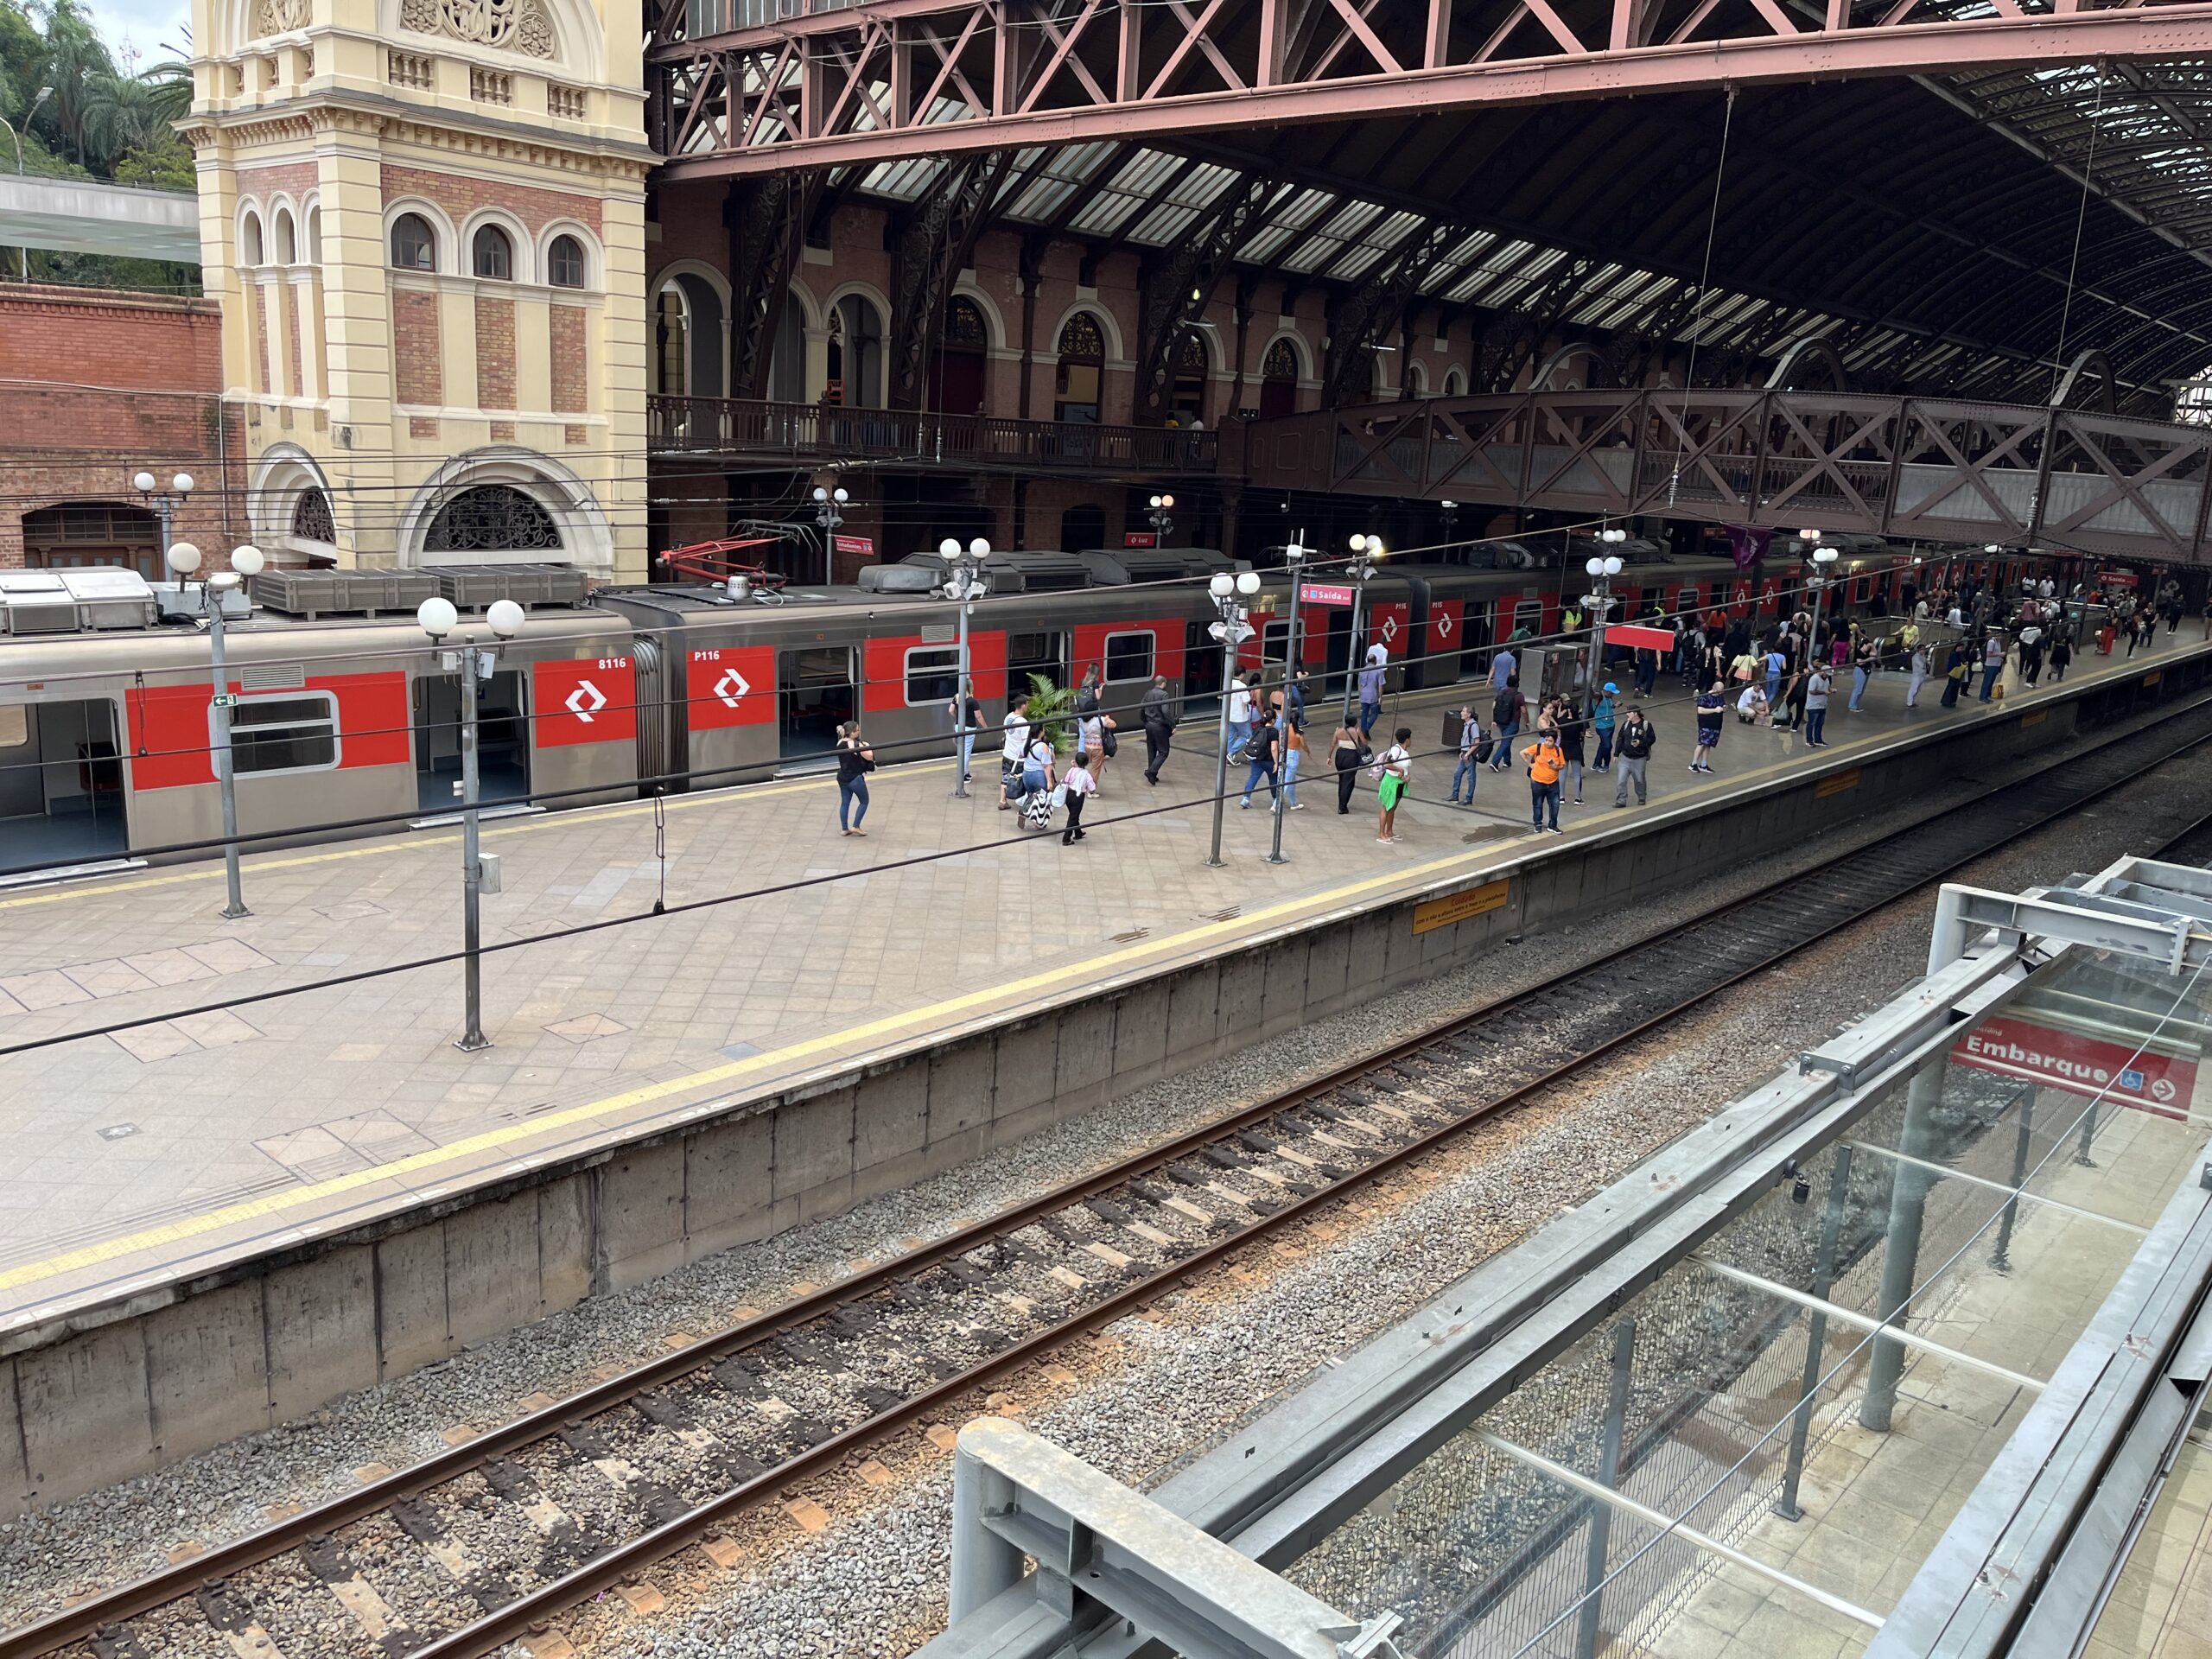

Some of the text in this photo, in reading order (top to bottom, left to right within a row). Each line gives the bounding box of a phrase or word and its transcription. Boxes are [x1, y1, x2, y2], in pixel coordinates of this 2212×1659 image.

[1319, 590, 1342, 600] Saída
[694, 651, 720, 661] P116
[598, 658, 626, 670] 8116
[1967, 1035, 2109, 1082] Embarque
